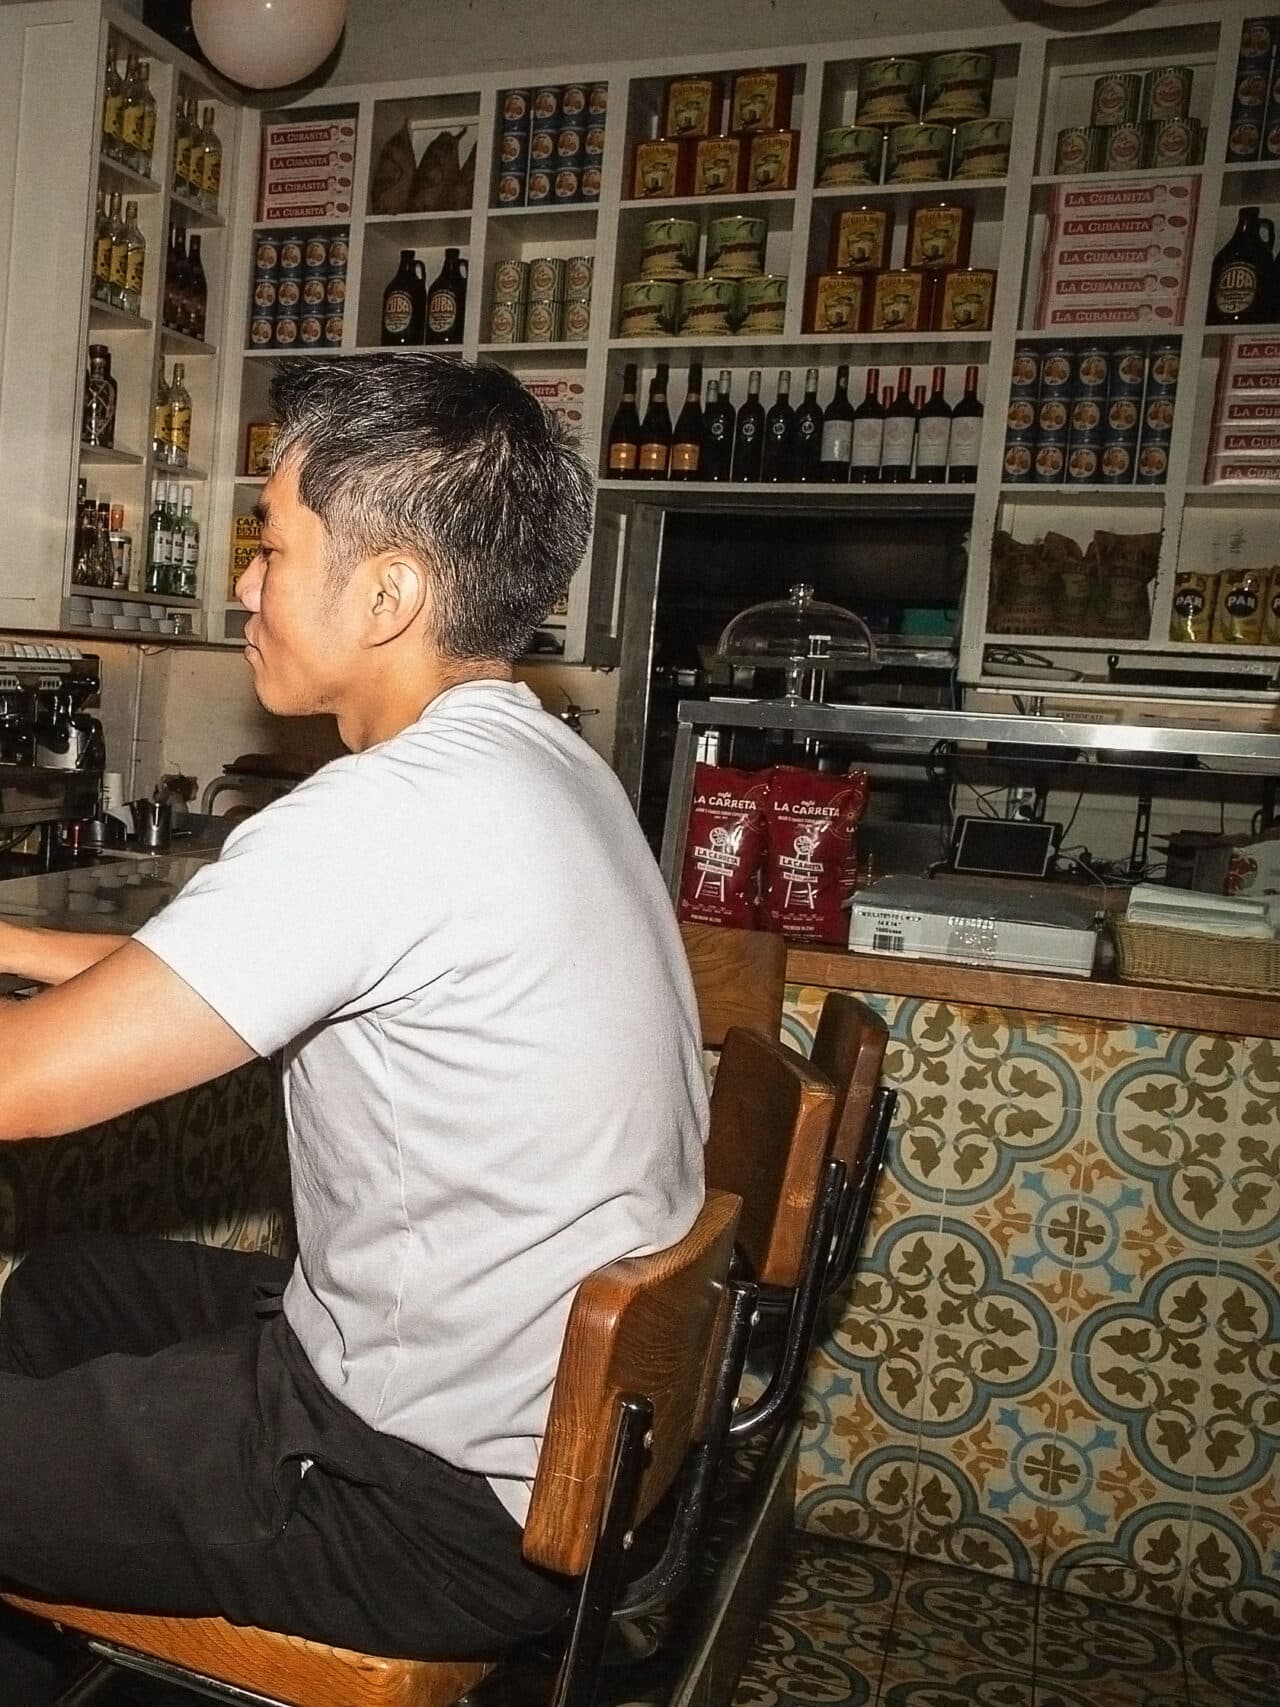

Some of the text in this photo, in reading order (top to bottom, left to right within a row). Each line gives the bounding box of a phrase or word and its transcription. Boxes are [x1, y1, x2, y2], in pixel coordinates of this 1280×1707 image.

[1069, 191, 1151, 206] LA CUBANITA
[1068, 221, 1150, 233] LA CUBANITA
[1063, 250, 1145, 263] LA CUBANITA
[1061, 279, 1141, 292] LA CUBANITA
[1056, 308, 1137, 321] LA CUBANITA
[1242, 346, 1260, 356] LA
[1237, 376, 1255, 387] LA
[1233, 407, 1251, 417] LA
[1229, 437, 1247, 448] LA
[1225, 467, 1242, 478] LA
[708, 796, 757, 811] CARRETA
[773, 801, 840, 817] LA CARRETA
[697, 848, 708, 858] LA
[782, 857, 793, 867] LA
